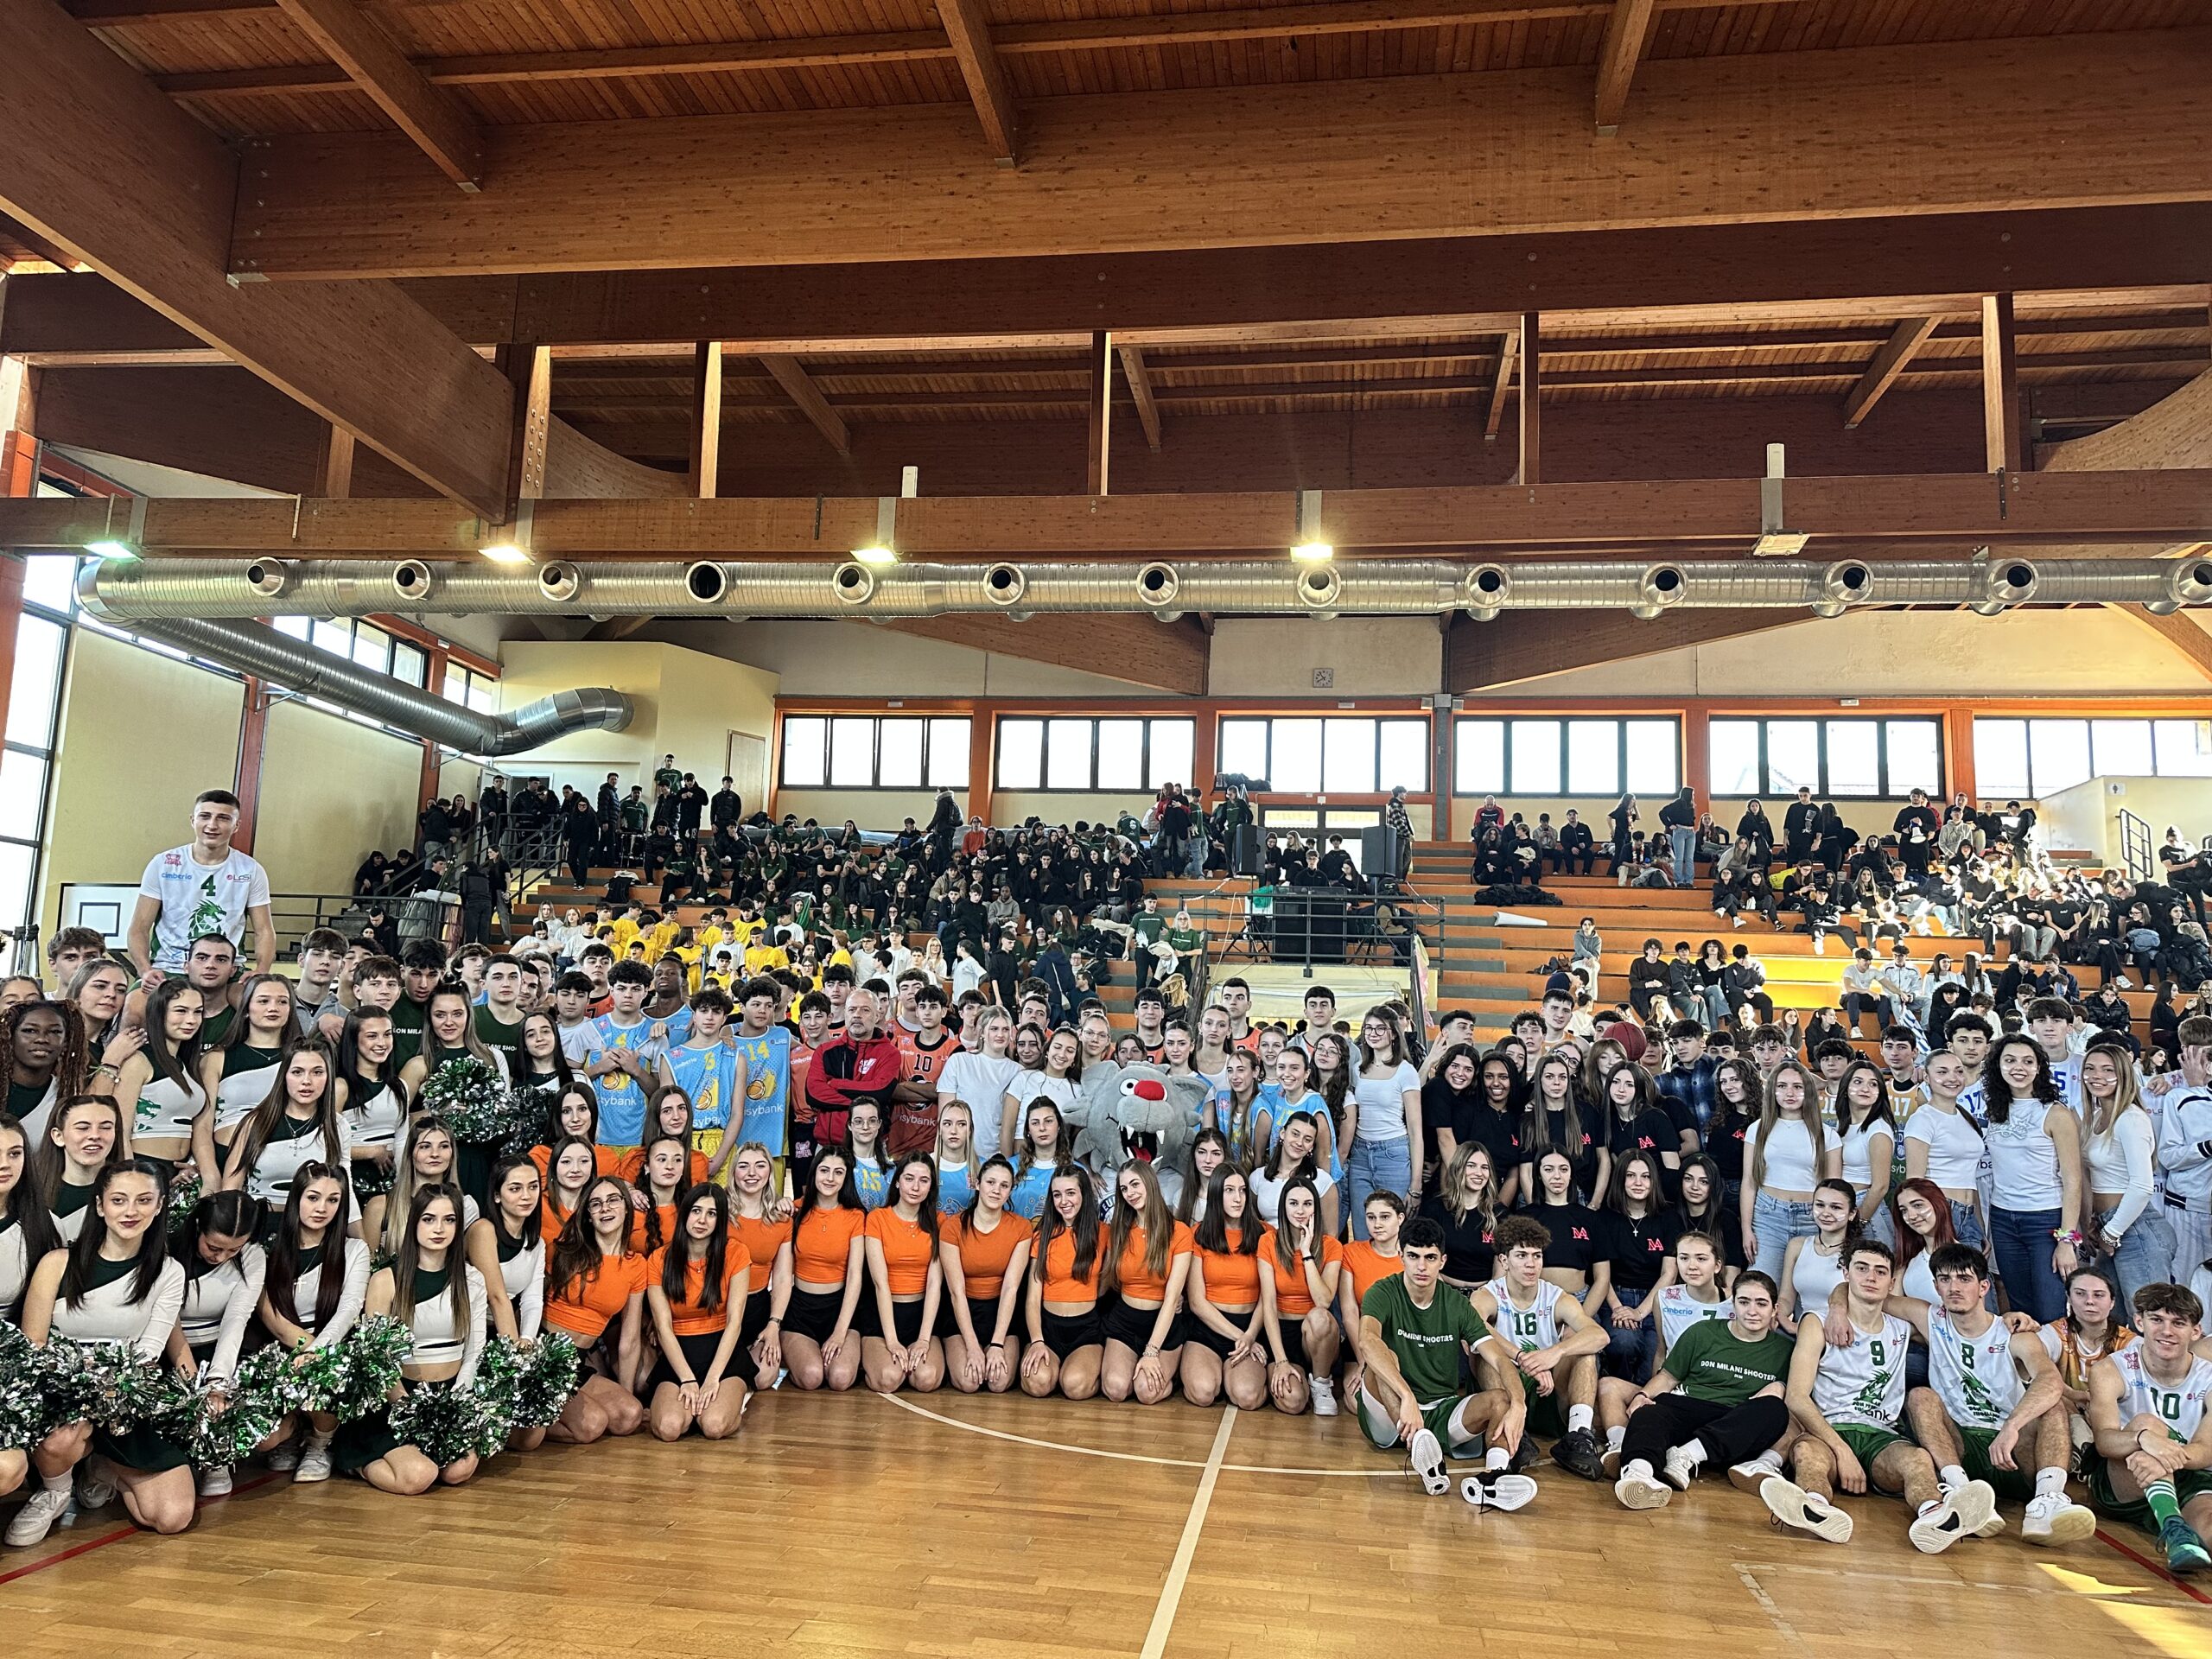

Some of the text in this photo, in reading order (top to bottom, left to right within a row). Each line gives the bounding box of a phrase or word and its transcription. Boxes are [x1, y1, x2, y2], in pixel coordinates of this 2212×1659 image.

[200, 874, 216, 896] 4
[747, 1040, 770, 1061] 14
[913, 1053, 933, 1072] 10
[745, 1104, 783, 1116] sybank
[1894, 1096, 1911, 1116] 17
[862, 1169, 881, 1191] 15
[1514, 1313, 1537, 1335] 16
[1869, 1340, 1885, 1366] 9
[1961, 1342, 1974, 1370] 8
[1717, 1362, 1743, 1374] MILANI
[2150, 1387, 2181, 1420] 10
